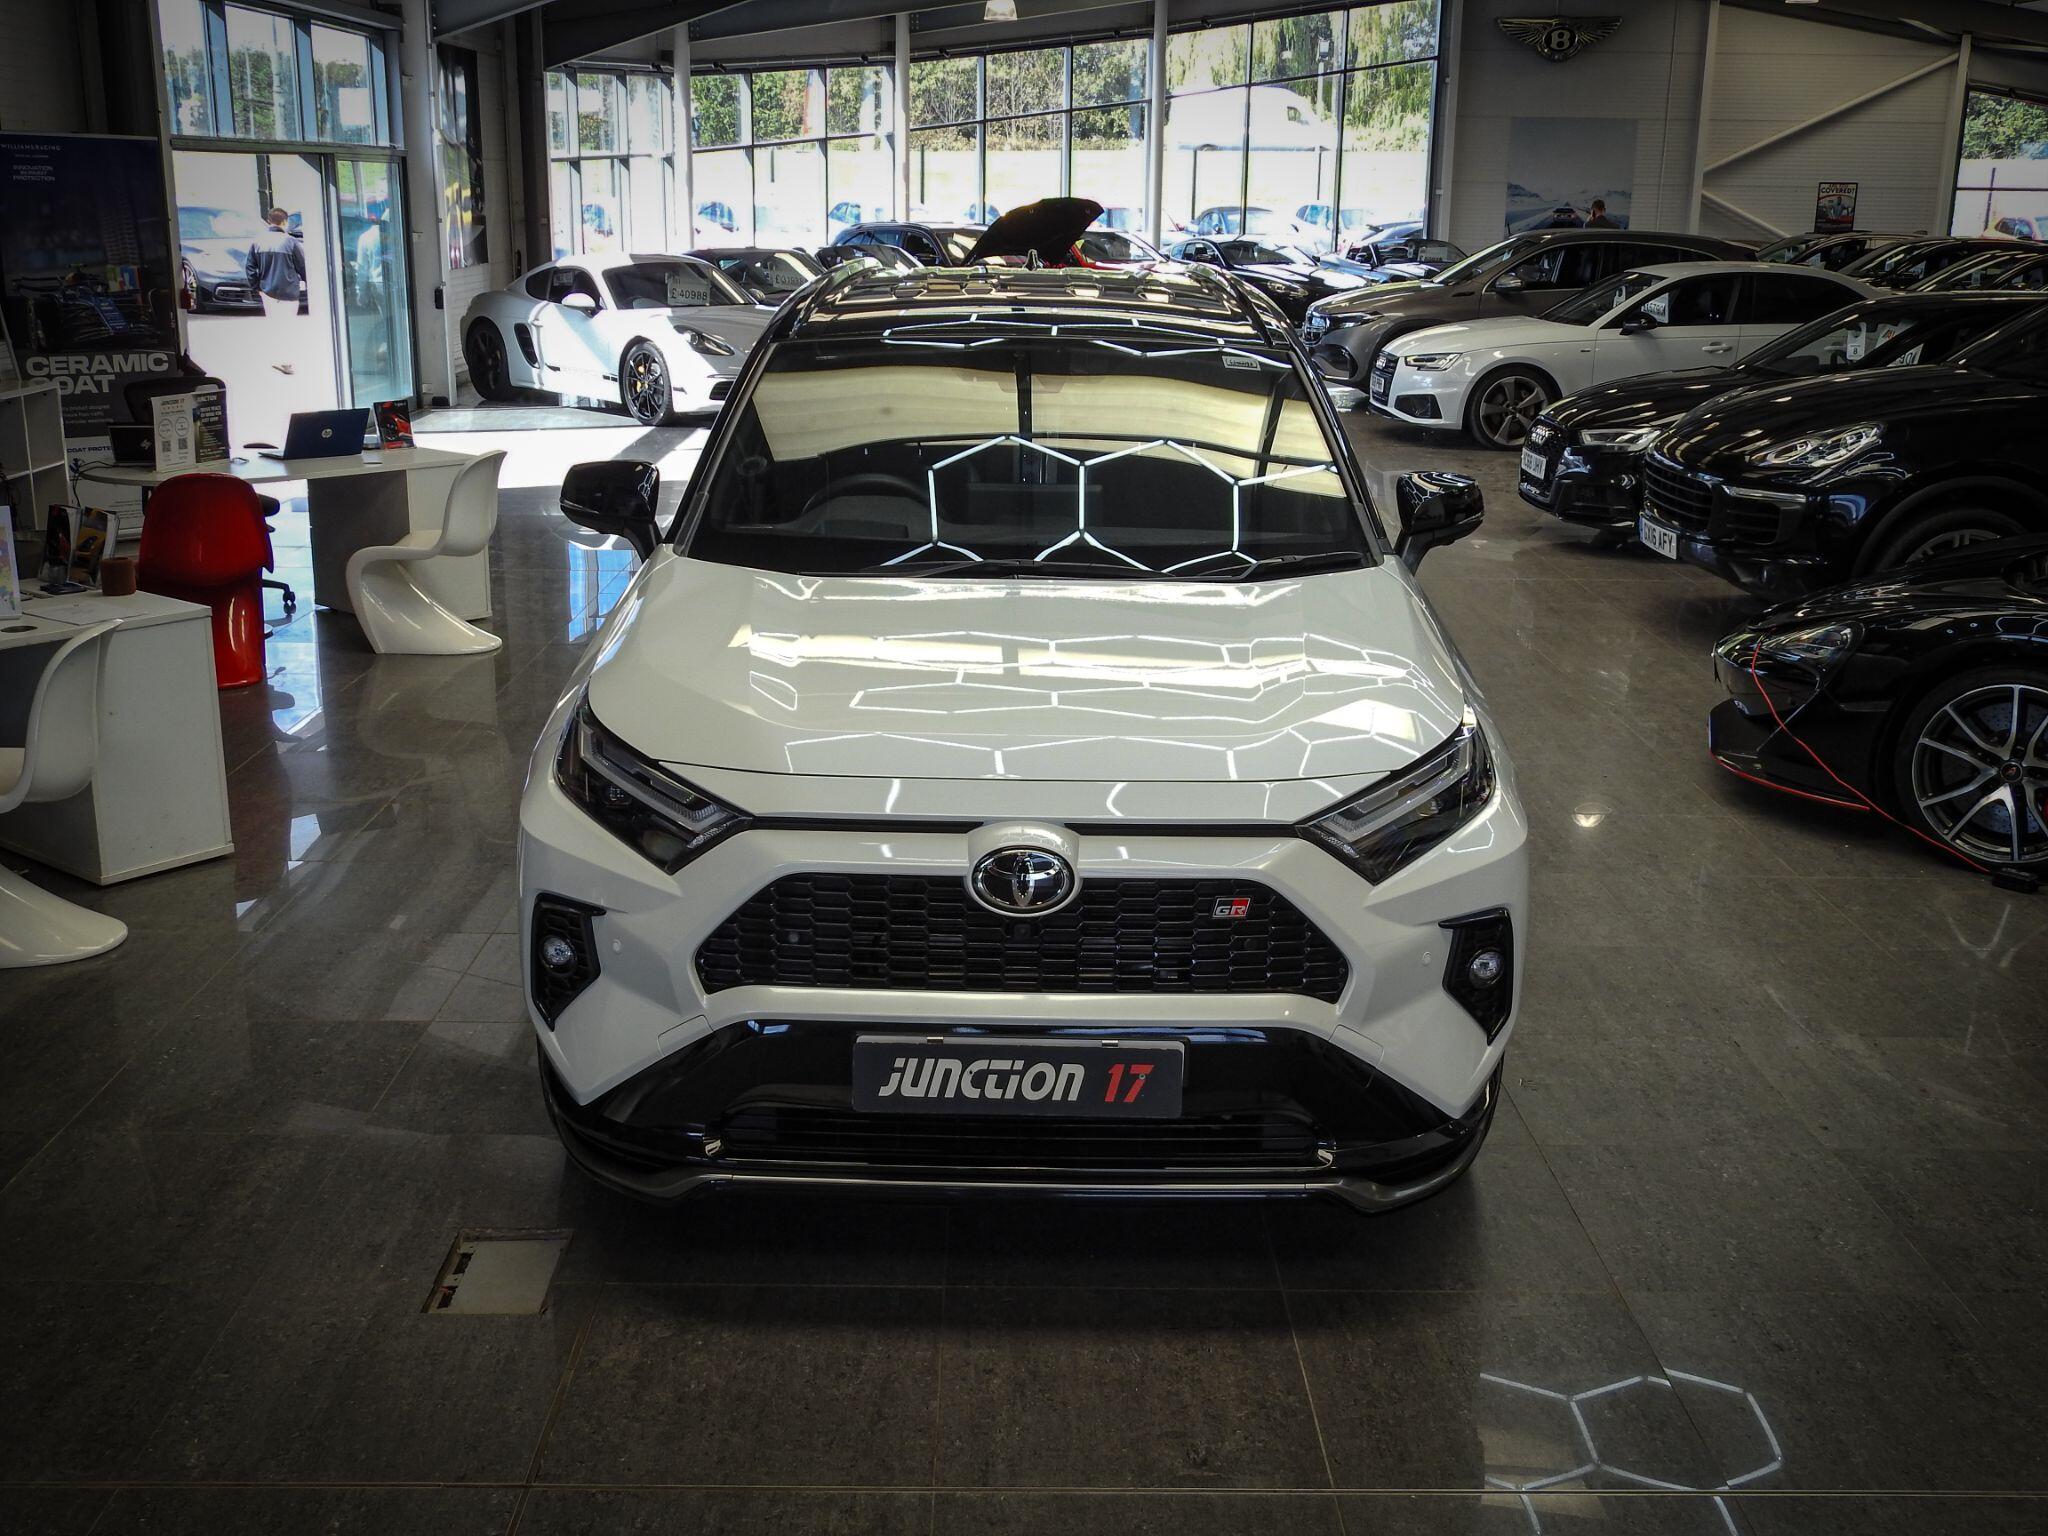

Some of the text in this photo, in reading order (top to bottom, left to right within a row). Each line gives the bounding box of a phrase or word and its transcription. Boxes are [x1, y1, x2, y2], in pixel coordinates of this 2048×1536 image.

[26, 352, 169, 376] CERAMIC
[1215, 905, 1246, 916] GR
[1104, 1063, 1154, 1103] 17
